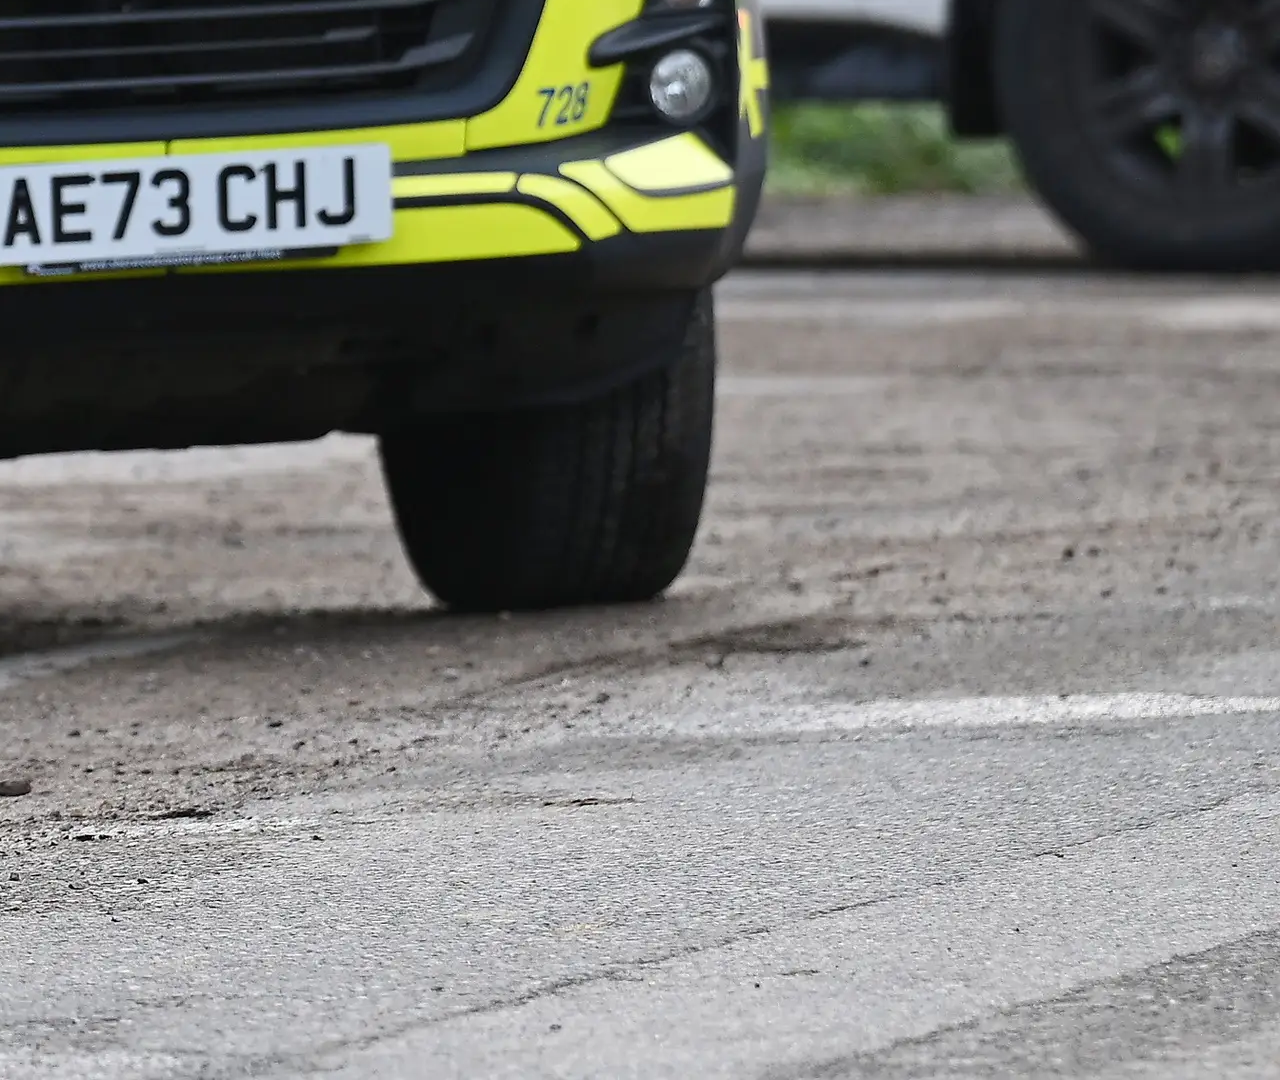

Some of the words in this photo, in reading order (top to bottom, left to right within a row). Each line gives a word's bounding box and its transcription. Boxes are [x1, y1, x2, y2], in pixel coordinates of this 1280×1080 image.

[537, 81, 591, 128] 728
[3, 168, 192, 247] AE73
[217, 157, 357, 232] CHJ
